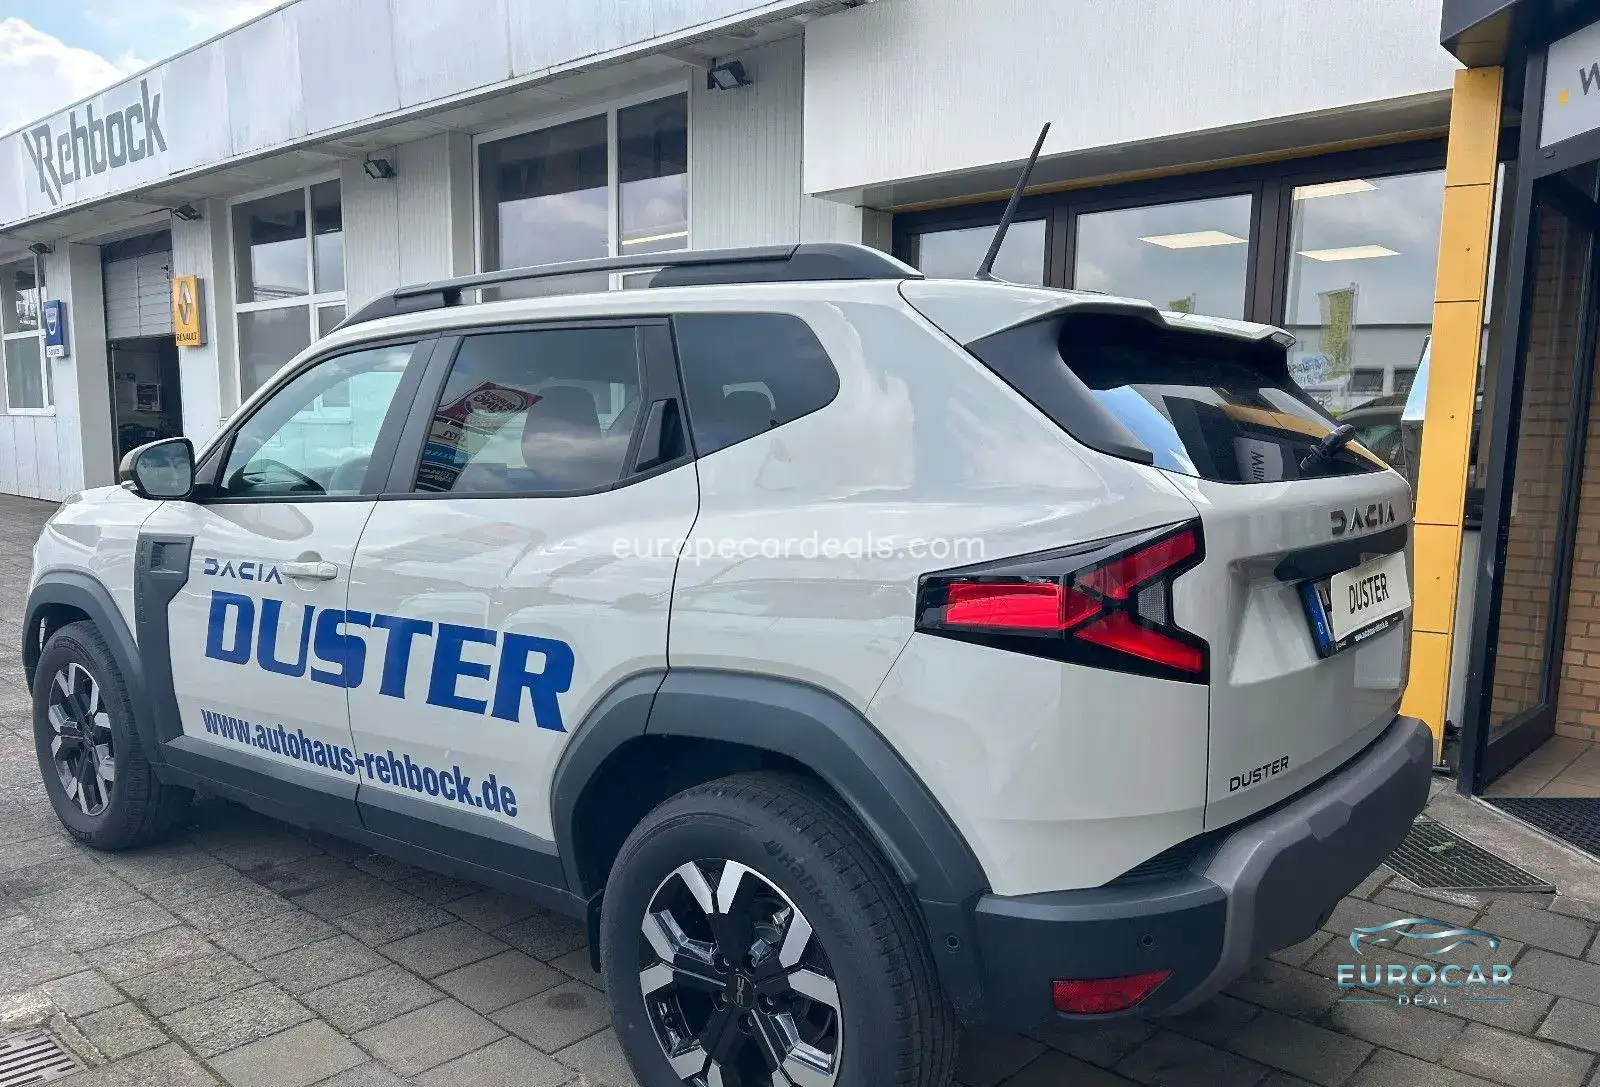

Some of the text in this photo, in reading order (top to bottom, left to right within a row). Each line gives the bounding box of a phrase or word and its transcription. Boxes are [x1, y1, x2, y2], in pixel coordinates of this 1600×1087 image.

[22, 78, 168, 206] Rehbock
[176, 332, 198, 342] RENAULT
[1330, 501, 1396, 536] DACIA
[203, 557, 284, 585] DACIA
[1348, 572, 1389, 614] DUSTER
[205, 590, 575, 732] DUSTER
[200, 708, 519, 818] www.autohaus-rehbock.de
[1229, 755, 1289, 793] DUSTER
